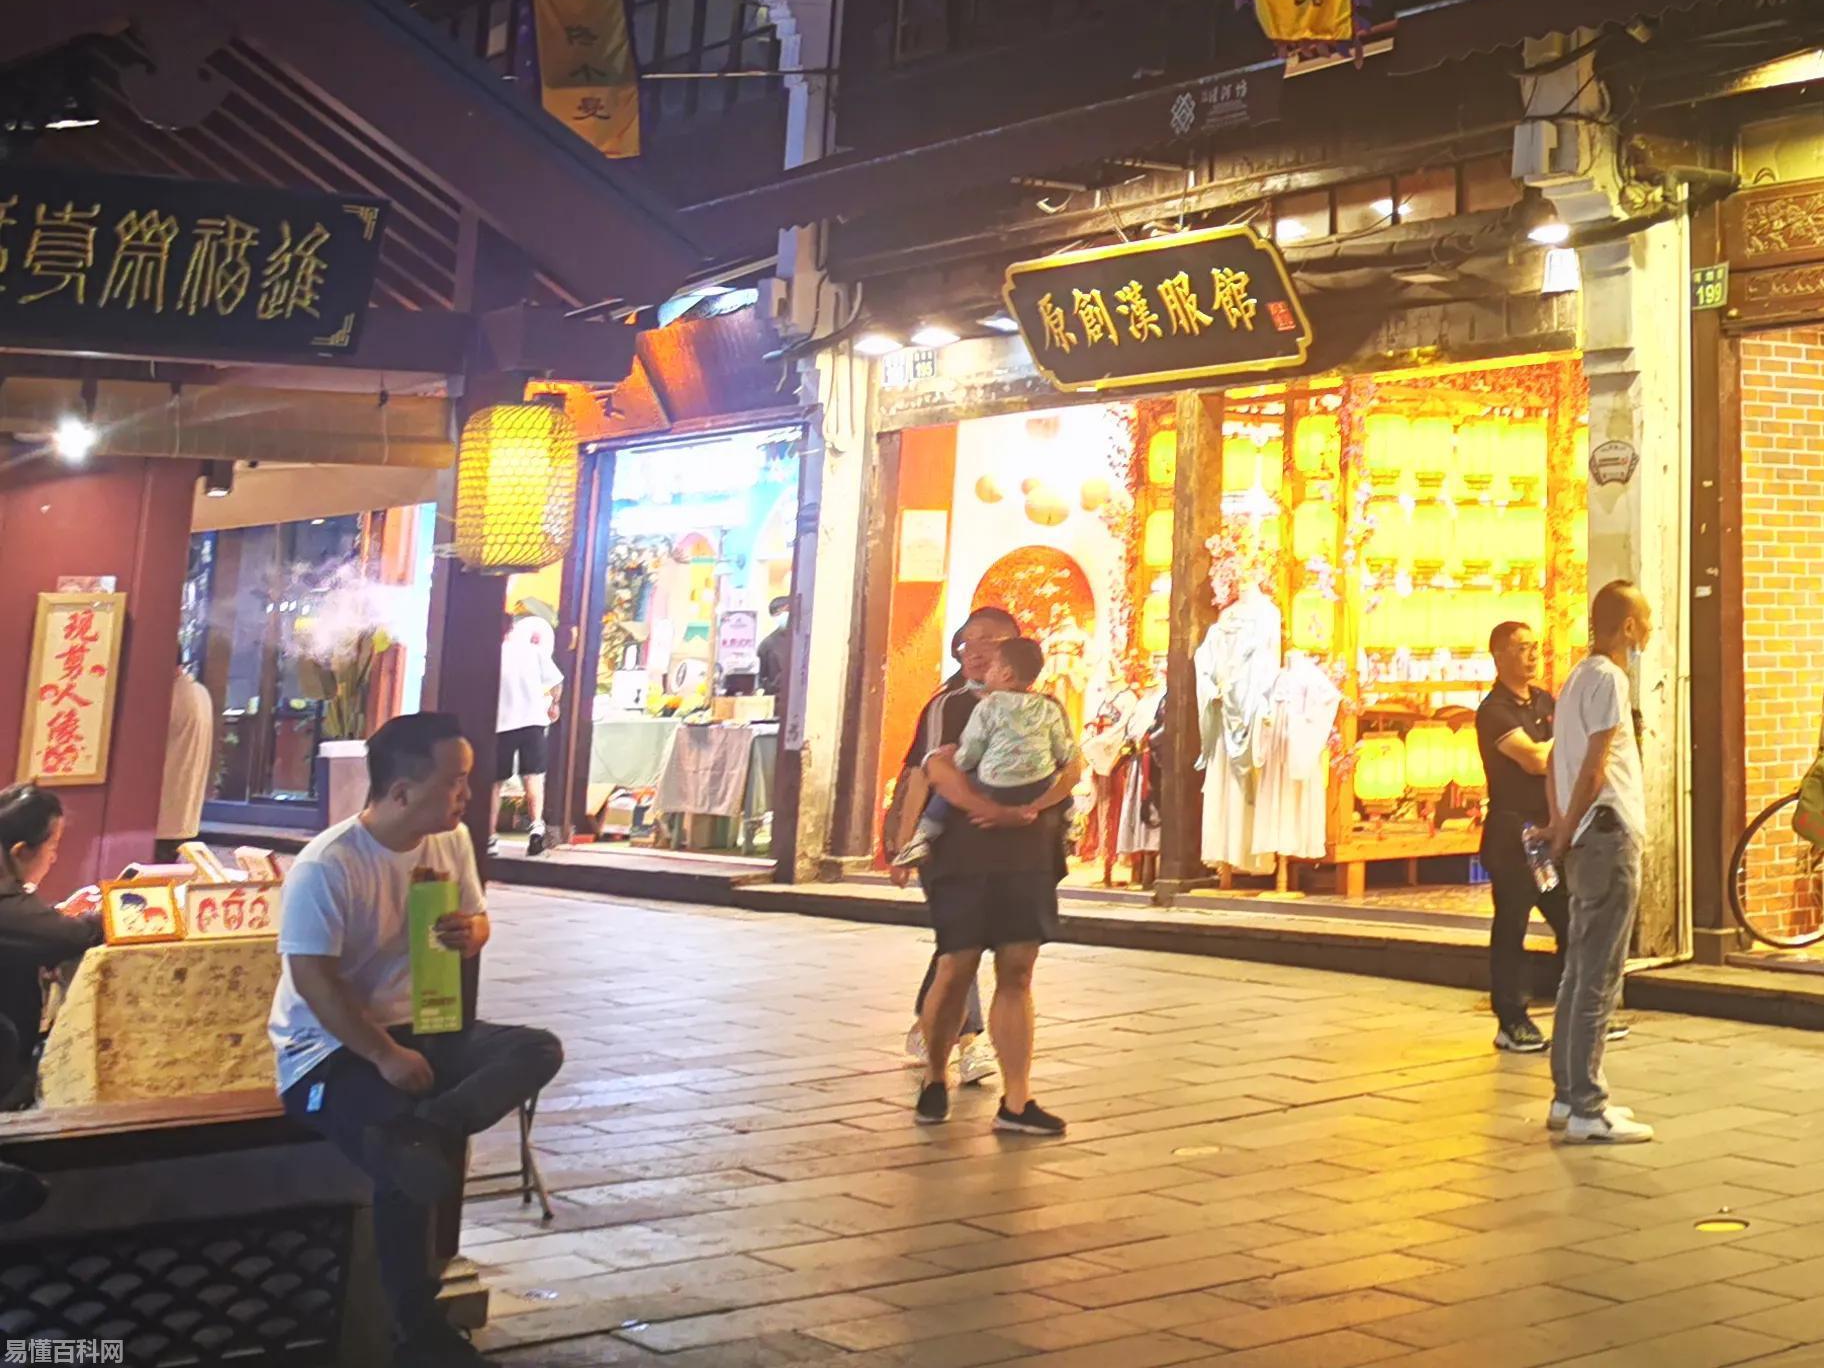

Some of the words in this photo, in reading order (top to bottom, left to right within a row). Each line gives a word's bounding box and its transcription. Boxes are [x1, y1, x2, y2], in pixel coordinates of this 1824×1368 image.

[1036, 266, 1259, 355] 原創漢服館
[1696, 282, 1723, 305] 199
